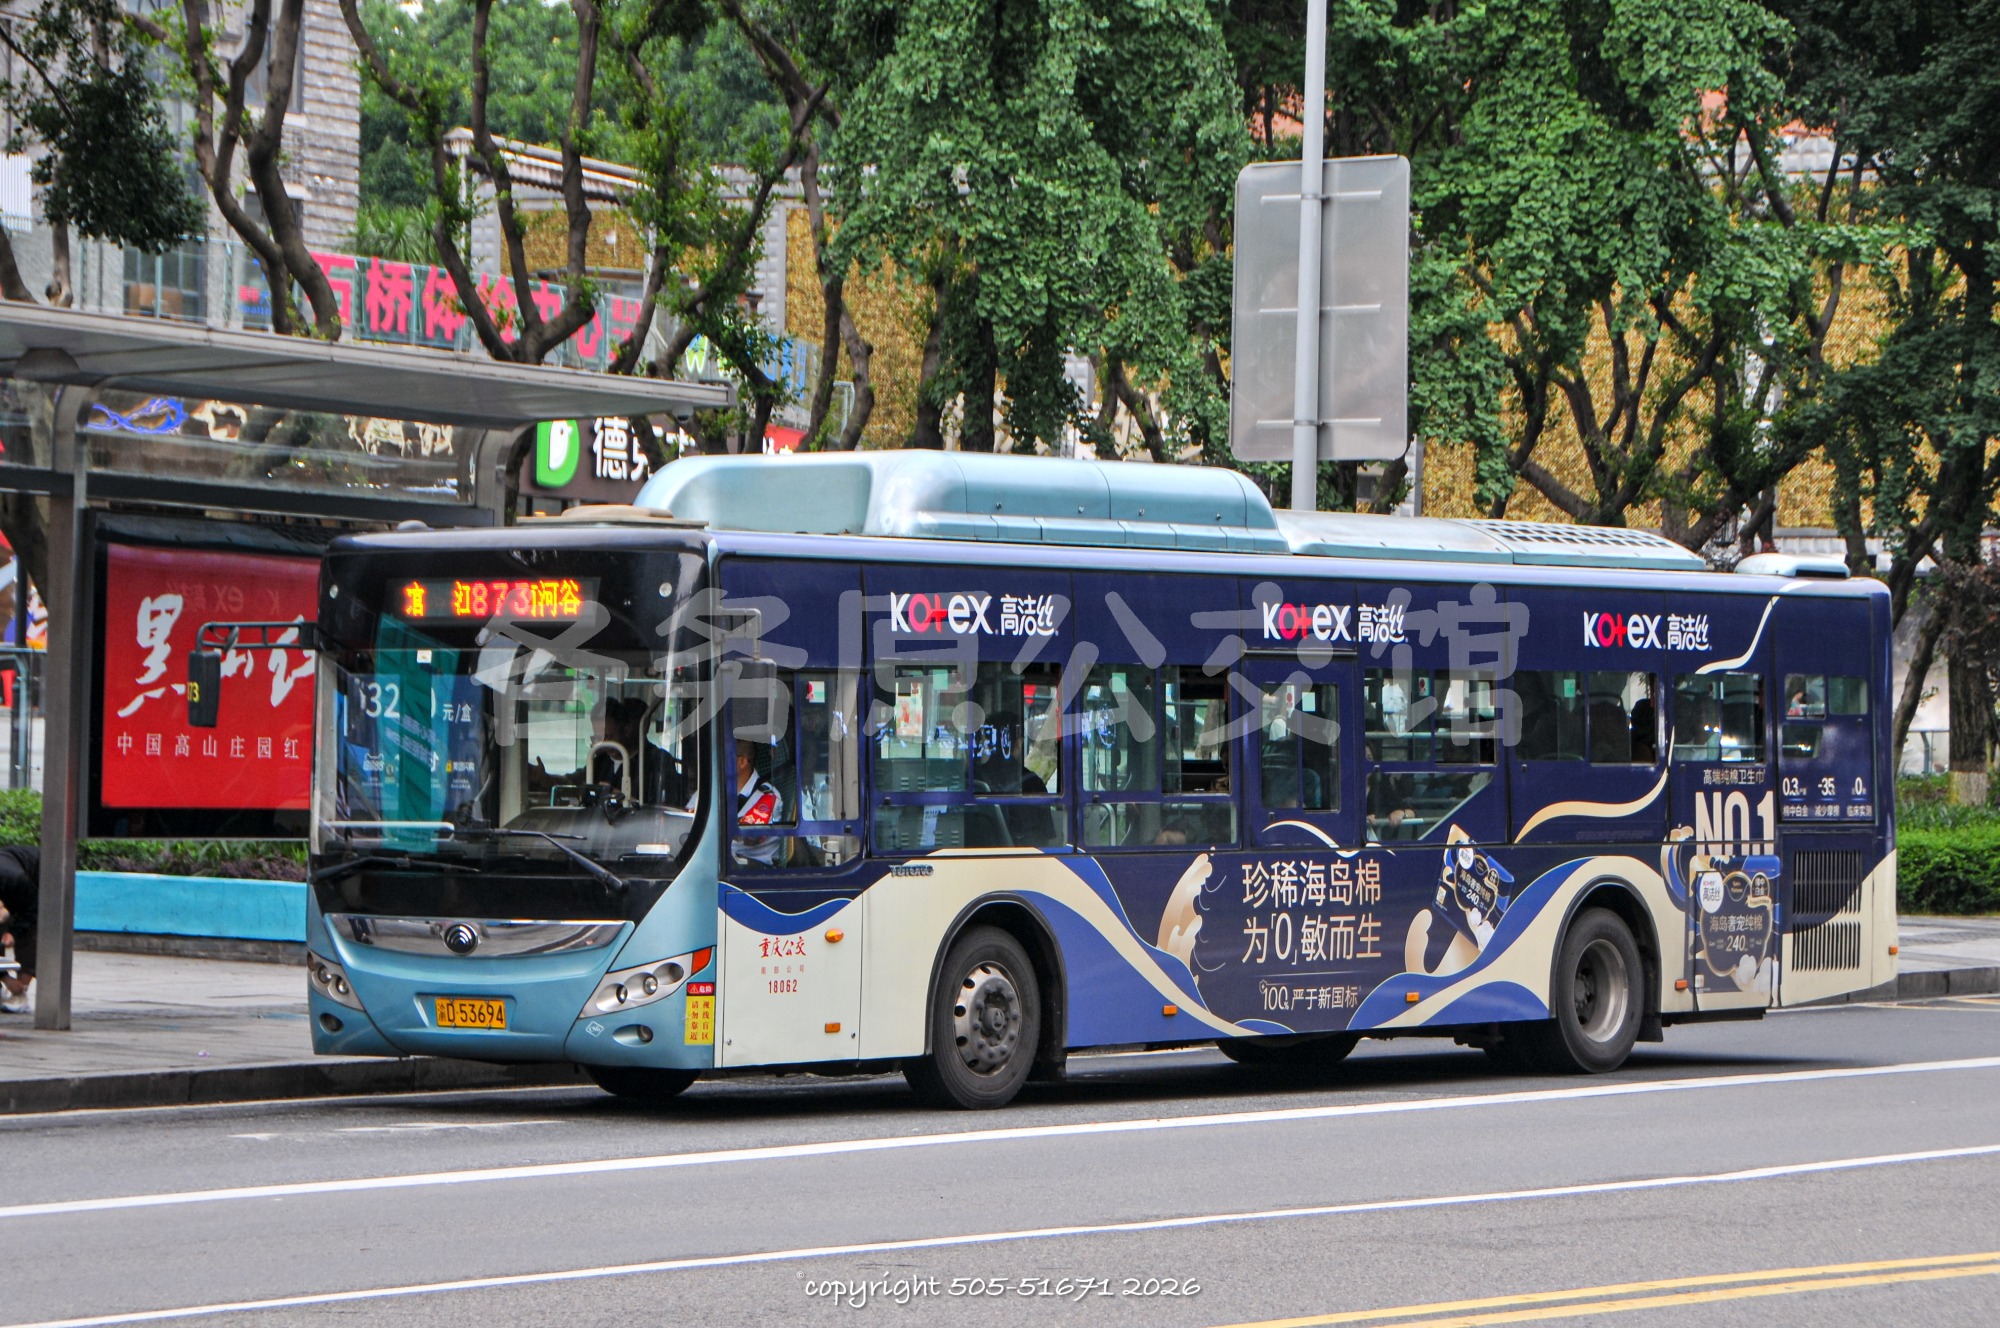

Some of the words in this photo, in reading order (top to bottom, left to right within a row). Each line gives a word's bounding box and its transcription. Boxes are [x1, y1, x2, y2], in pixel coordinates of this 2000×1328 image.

[472, 581, 531, 616] 873
[1000, 593, 1055, 636] 高洁丝
[1358, 603, 1405, 643] 高洁丝
[1667, 613, 1709, 651] 高洁丝
[117, 731, 299, 759] 中国高山庄园红
[1695, 790, 1775, 857] NO.1
[1242, 858, 1381, 908] 珍稀海岛棉
[759, 936, 806, 958] 重庆公交
[768, 979, 798, 994] 18062
